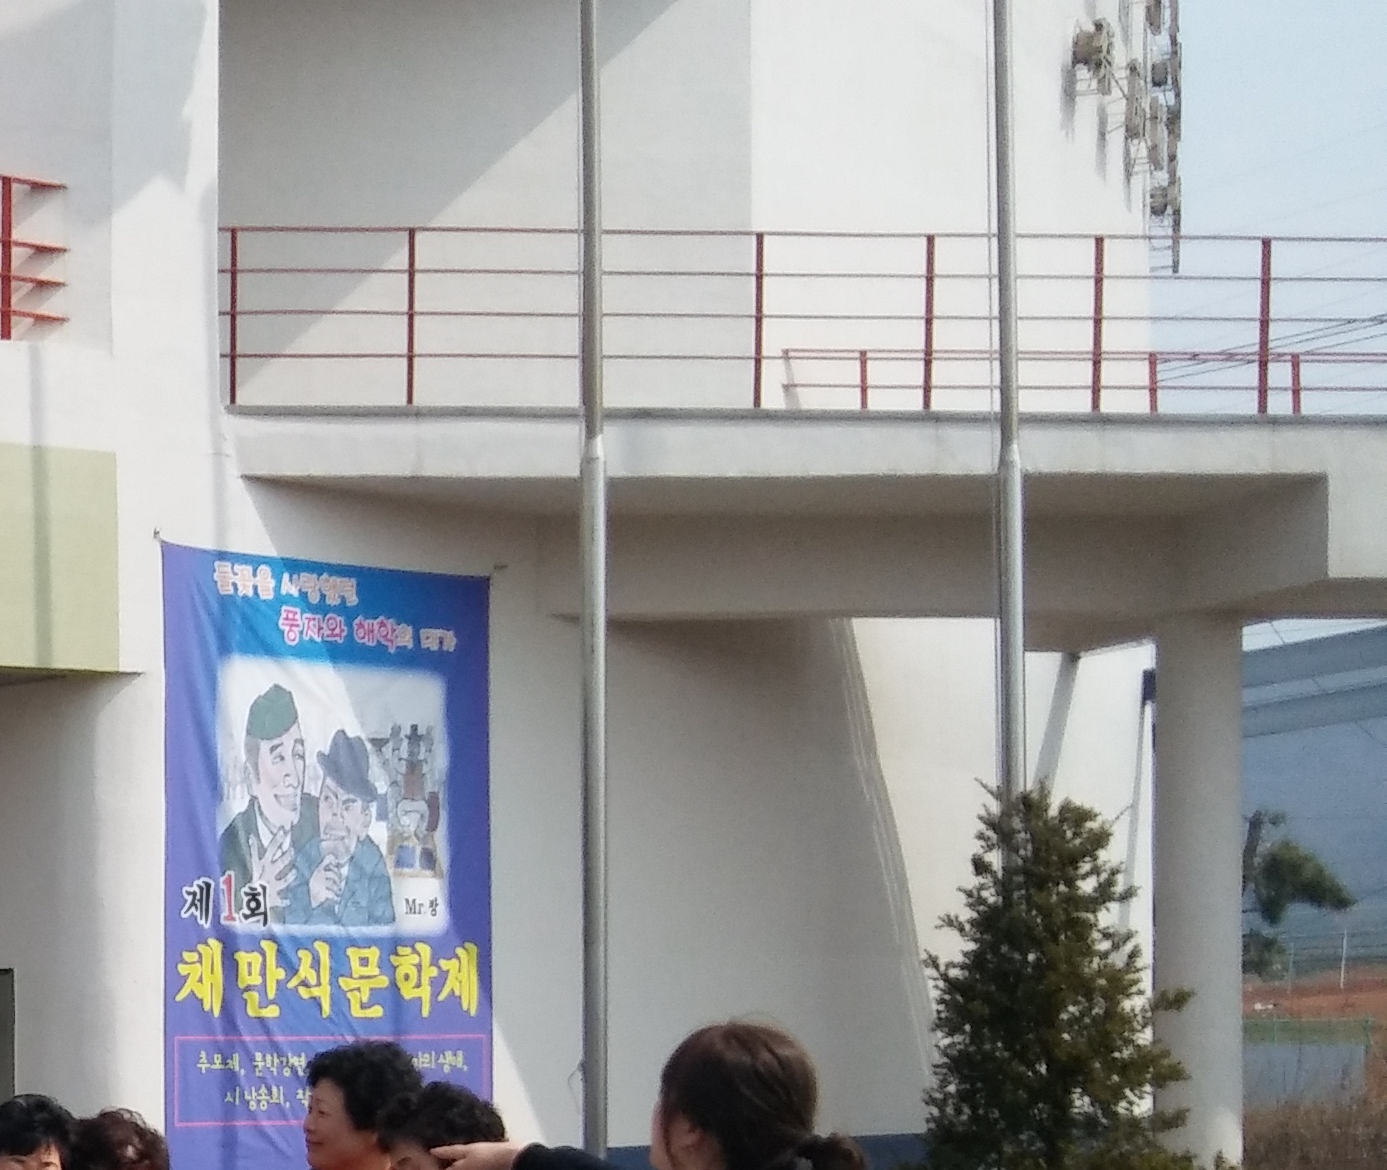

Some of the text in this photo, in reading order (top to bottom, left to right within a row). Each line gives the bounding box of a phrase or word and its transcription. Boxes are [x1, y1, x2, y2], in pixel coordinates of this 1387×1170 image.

[279, 605, 348, 645] 풍자와
[353, 615, 414, 653] 해학의
[180, 870, 270, 928] 제1회
[175, 937, 480, 1019] 채만식문학제
